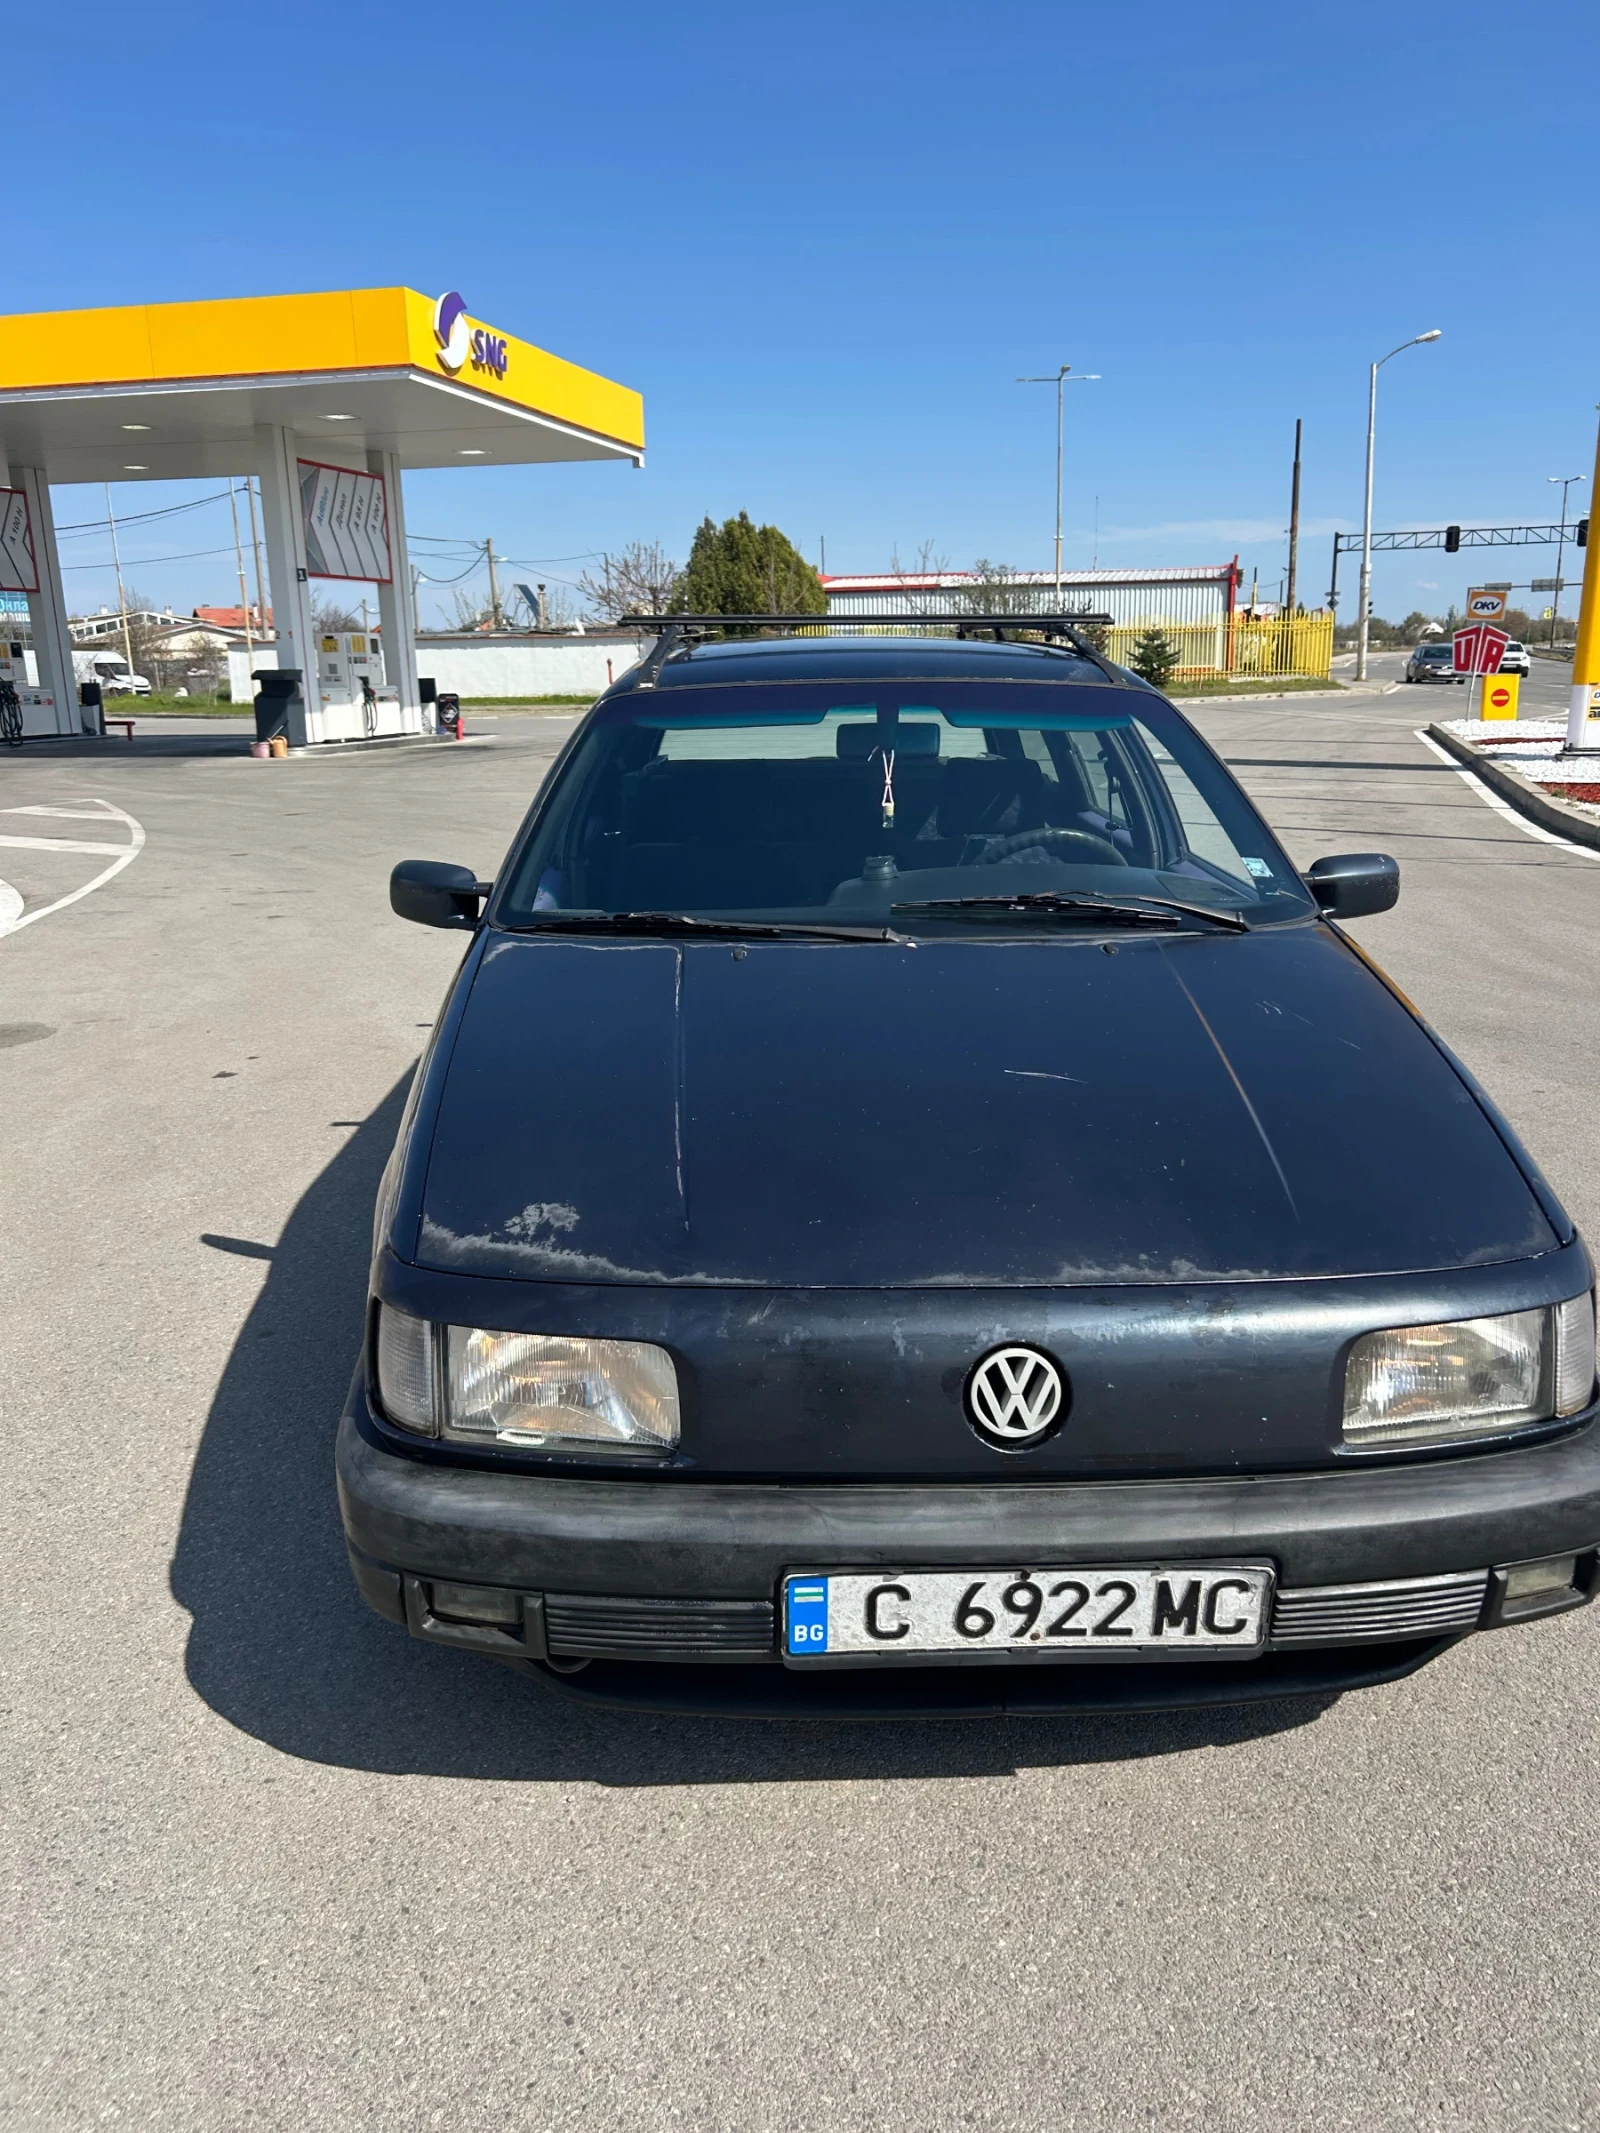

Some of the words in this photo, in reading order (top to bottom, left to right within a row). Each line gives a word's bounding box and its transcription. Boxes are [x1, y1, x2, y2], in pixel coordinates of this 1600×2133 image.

[472, 329, 507, 372] SNG
[12, 517, 20, 535] 100
[297, 570, 305, 580] 1
[1473, 601, 1500, 610] DKV
[864, 1582, 912, 1640] C
[955, 1580, 1138, 1640] 6922
[1151, 1578, 1250, 1637] MC
[794, 1624, 824, 1643] BG
